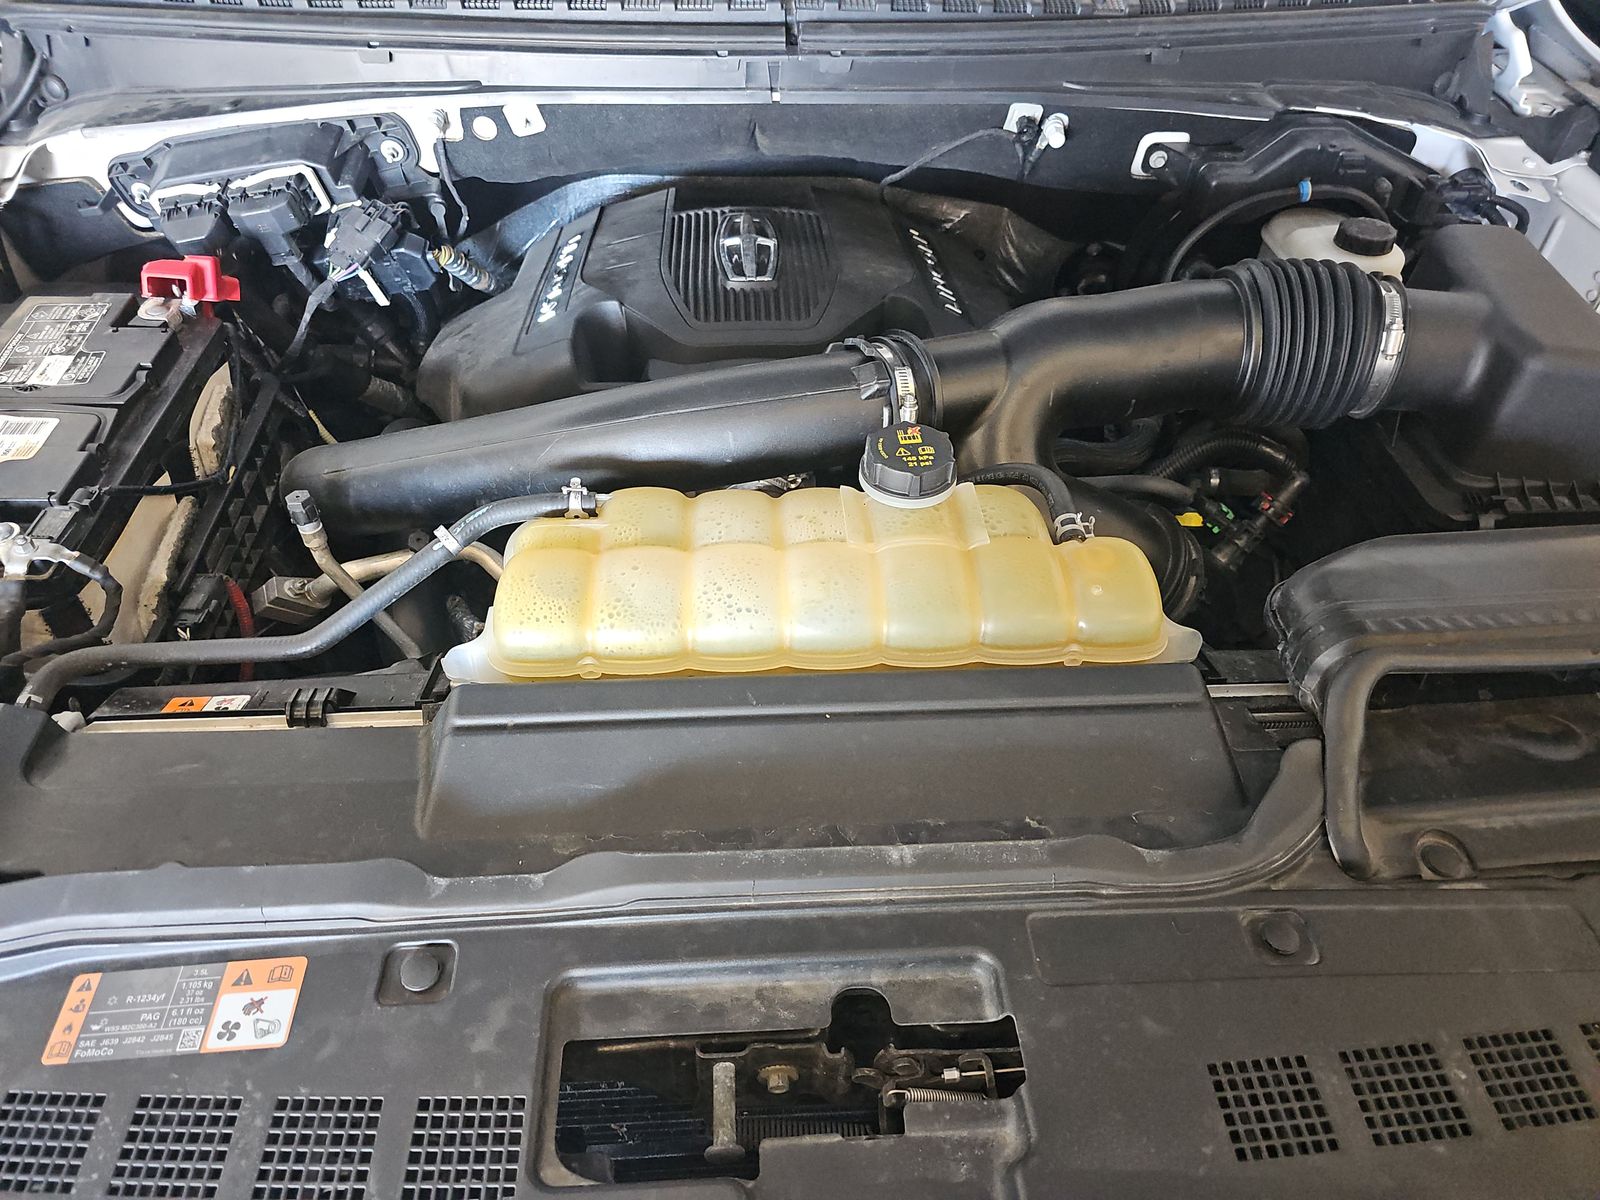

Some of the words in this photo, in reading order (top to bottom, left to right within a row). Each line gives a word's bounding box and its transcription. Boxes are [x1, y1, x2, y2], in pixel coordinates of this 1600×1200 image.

[203, 980, 214, 990] kg
[126, 993, 167, 1004] R-1234yf
[140, 1012, 161, 1022] PAG
[189, 1016, 203, 1026] cc)
[78, 1039, 97, 1048] SAE
[100, 1038, 119, 1047] J639
[122, 1035, 146, 1044] J2842
[74, 1047, 114, 1058] FoMoCo
